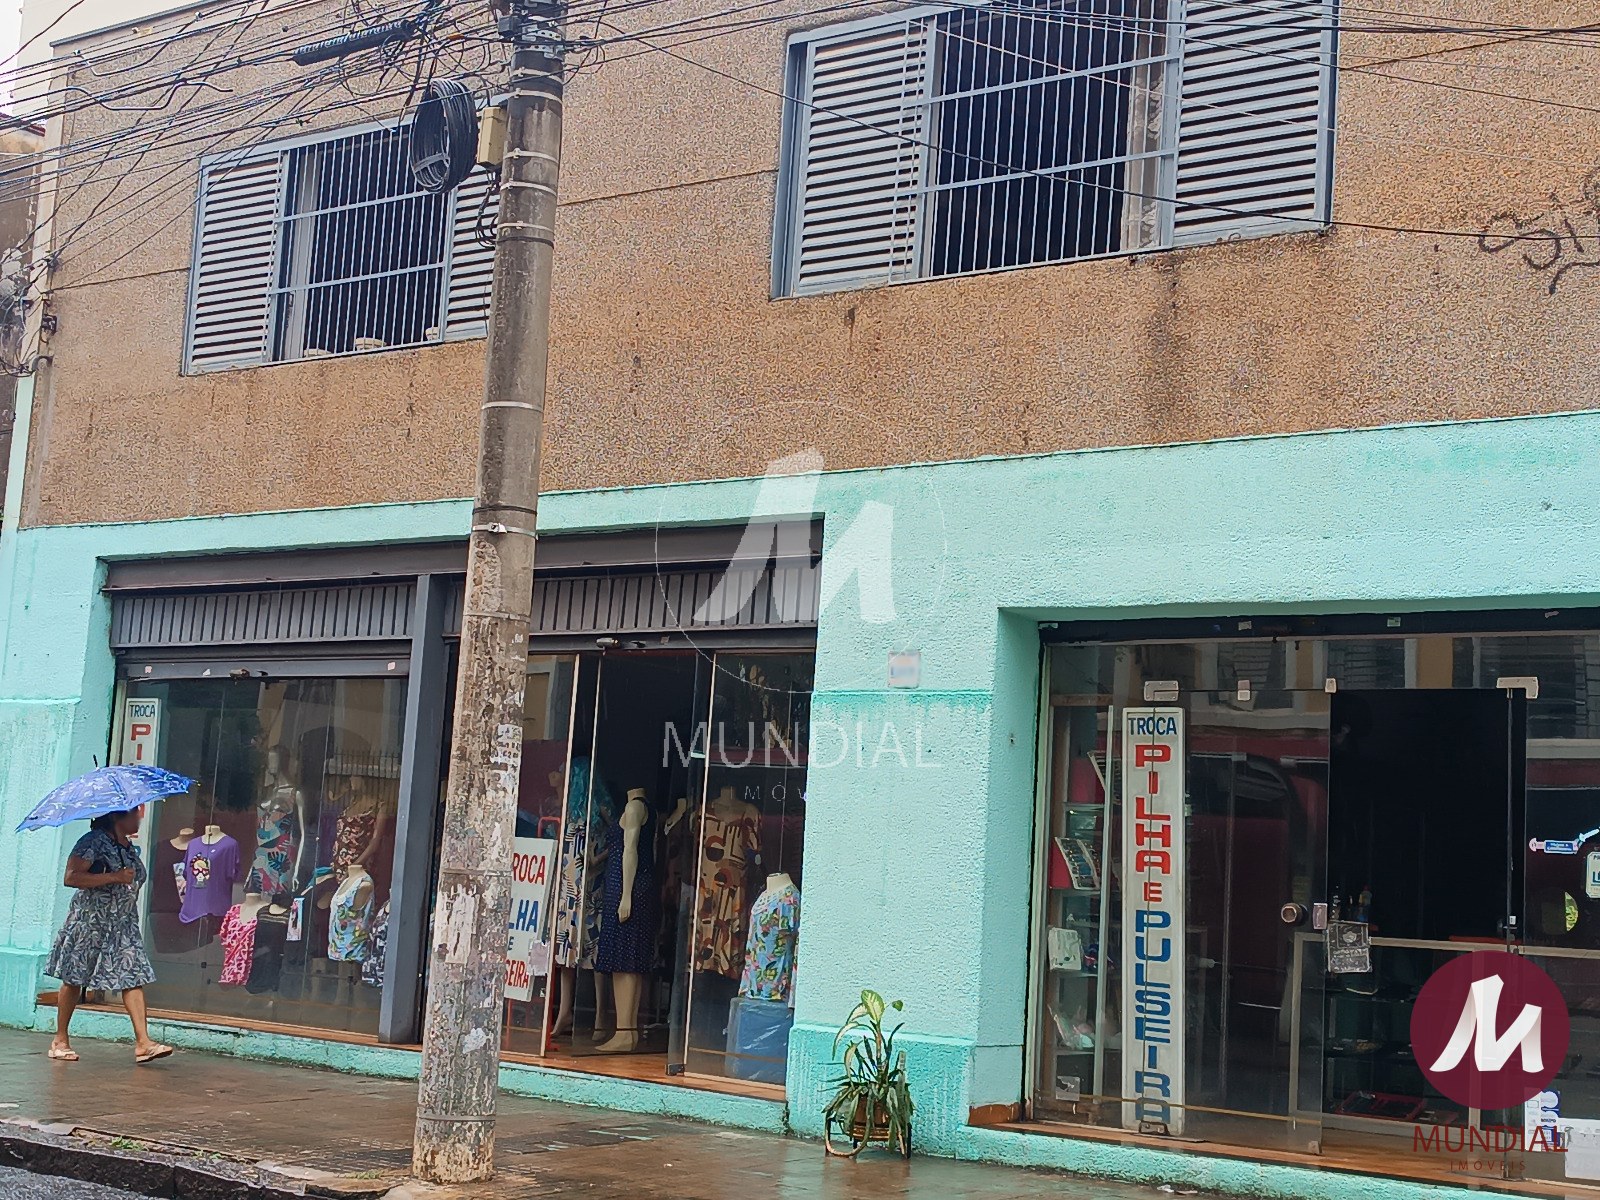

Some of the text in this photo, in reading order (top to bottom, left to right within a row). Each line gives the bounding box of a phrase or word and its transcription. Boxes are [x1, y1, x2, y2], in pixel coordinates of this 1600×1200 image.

[129, 704, 155, 718] TROCA
[1128, 717, 1177, 736] TROCA
[1135, 744, 1171, 875] PILHA
[512, 852, 546, 885] ROCA
[1144, 882, 1162, 903] E
[508, 898, 539, 933] LHA
[1135, 910, 1171, 1125] PULSEIRA
